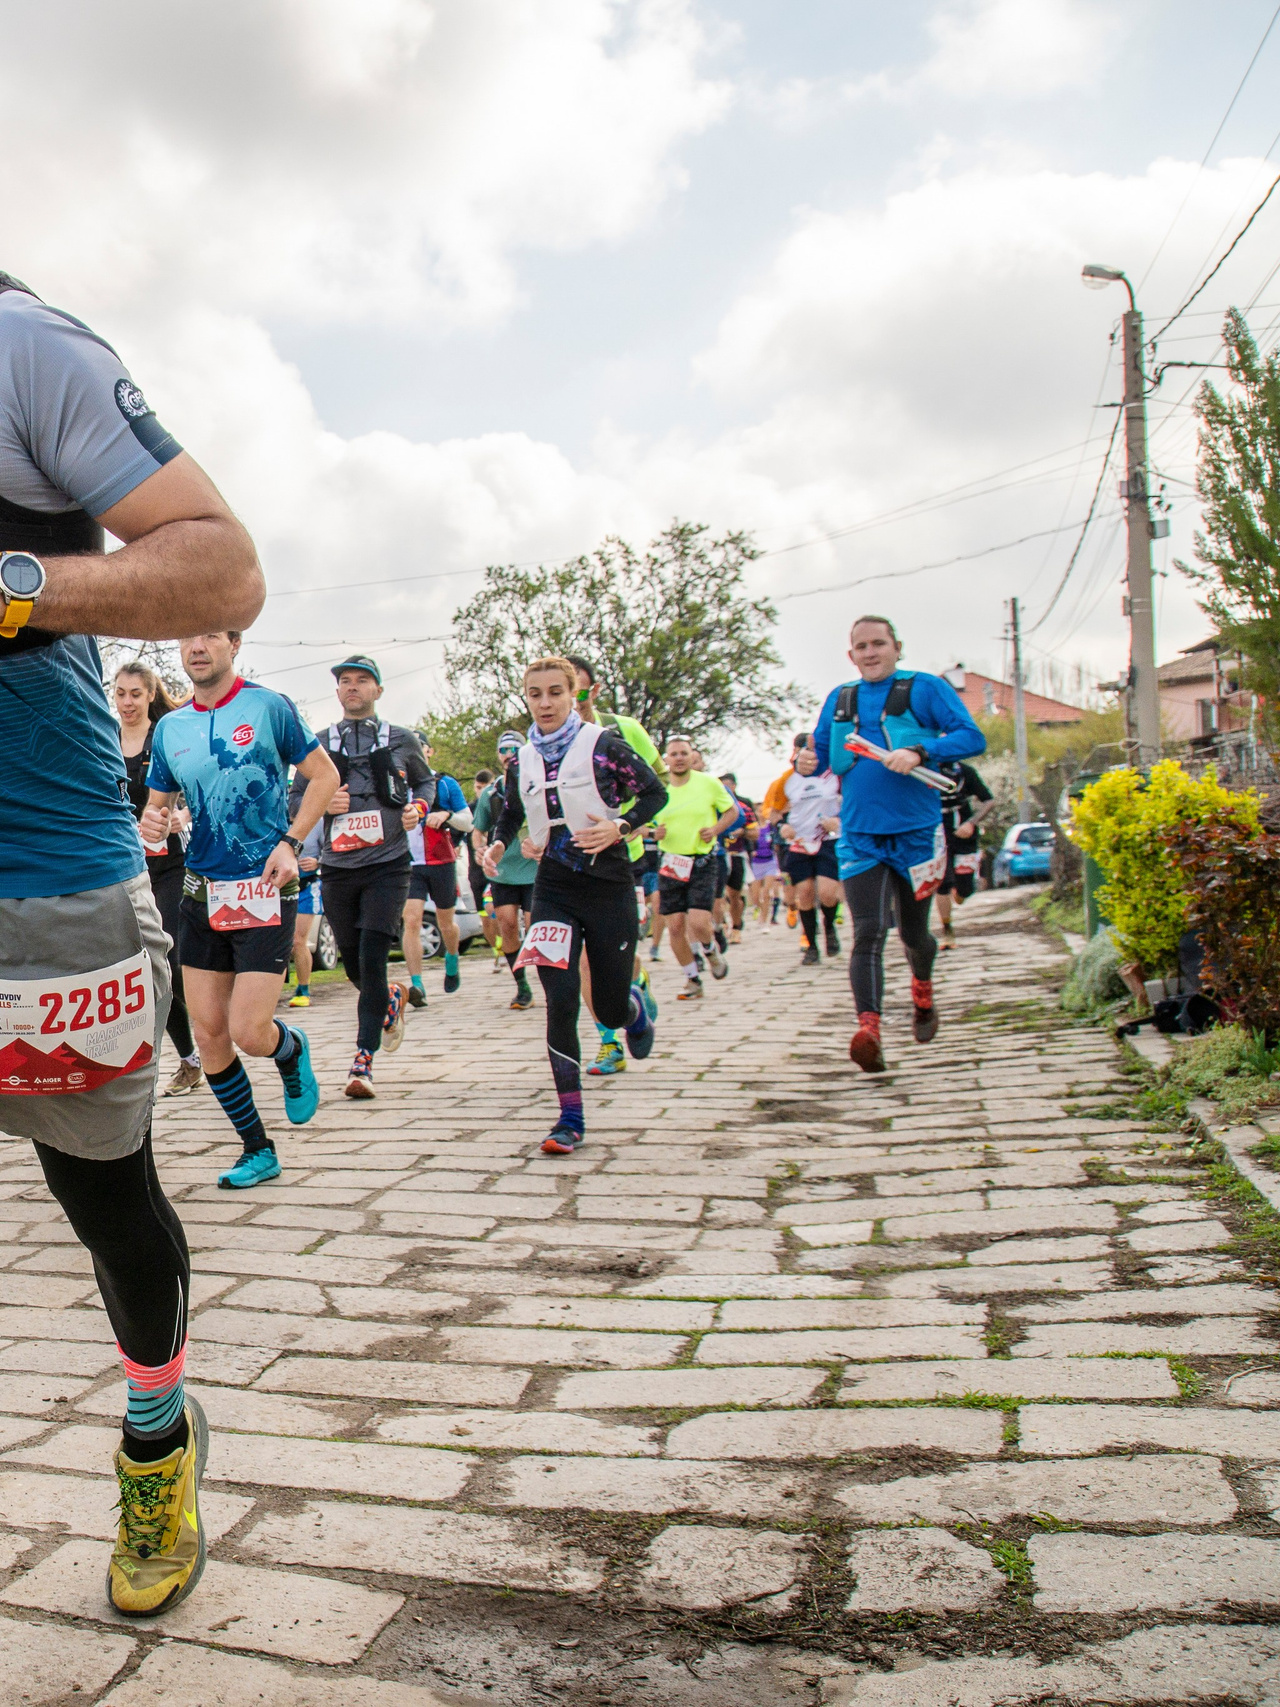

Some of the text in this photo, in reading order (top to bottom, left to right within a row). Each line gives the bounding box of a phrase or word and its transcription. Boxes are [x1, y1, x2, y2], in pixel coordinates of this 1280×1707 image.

[235, 730, 255, 740] EGT
[348, 815, 379, 831] 2209
[236, 881, 276, 901] 2142
[530, 926, 569, 943] 2327
[39, 968, 145, 1034] 2285
[86, 1013, 147, 1046] MARKOVO
[84, 1038, 119, 1058] TRAIL
